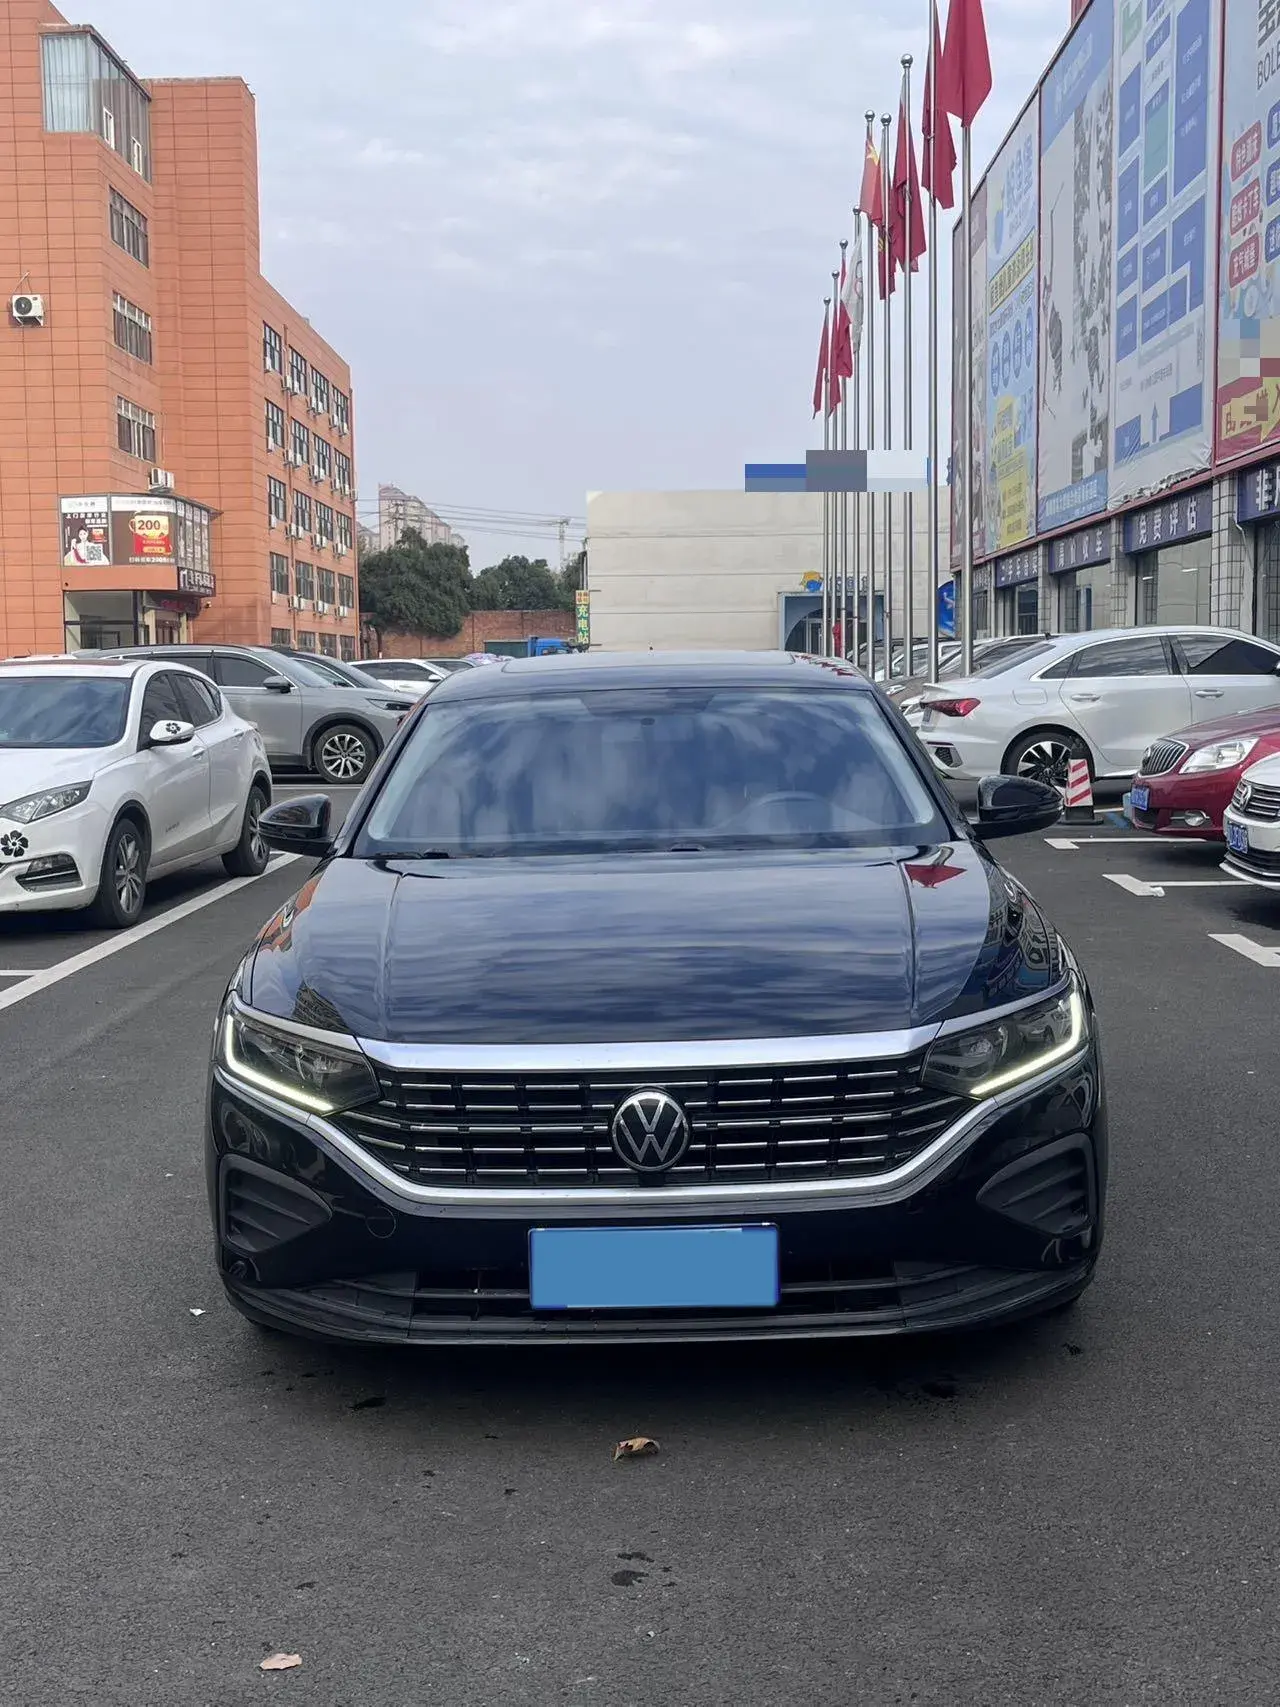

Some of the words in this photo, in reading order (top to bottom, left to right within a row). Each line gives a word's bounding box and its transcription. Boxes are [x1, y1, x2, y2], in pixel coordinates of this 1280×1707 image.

[1256, 466, 1280, 511] 非
[137, 519, 161, 530] 200
[1138, 497, 1198, 545] 免费评估
[1058, 530, 1103, 568] 高价收车
[577, 605, 589, 644] 充电站
